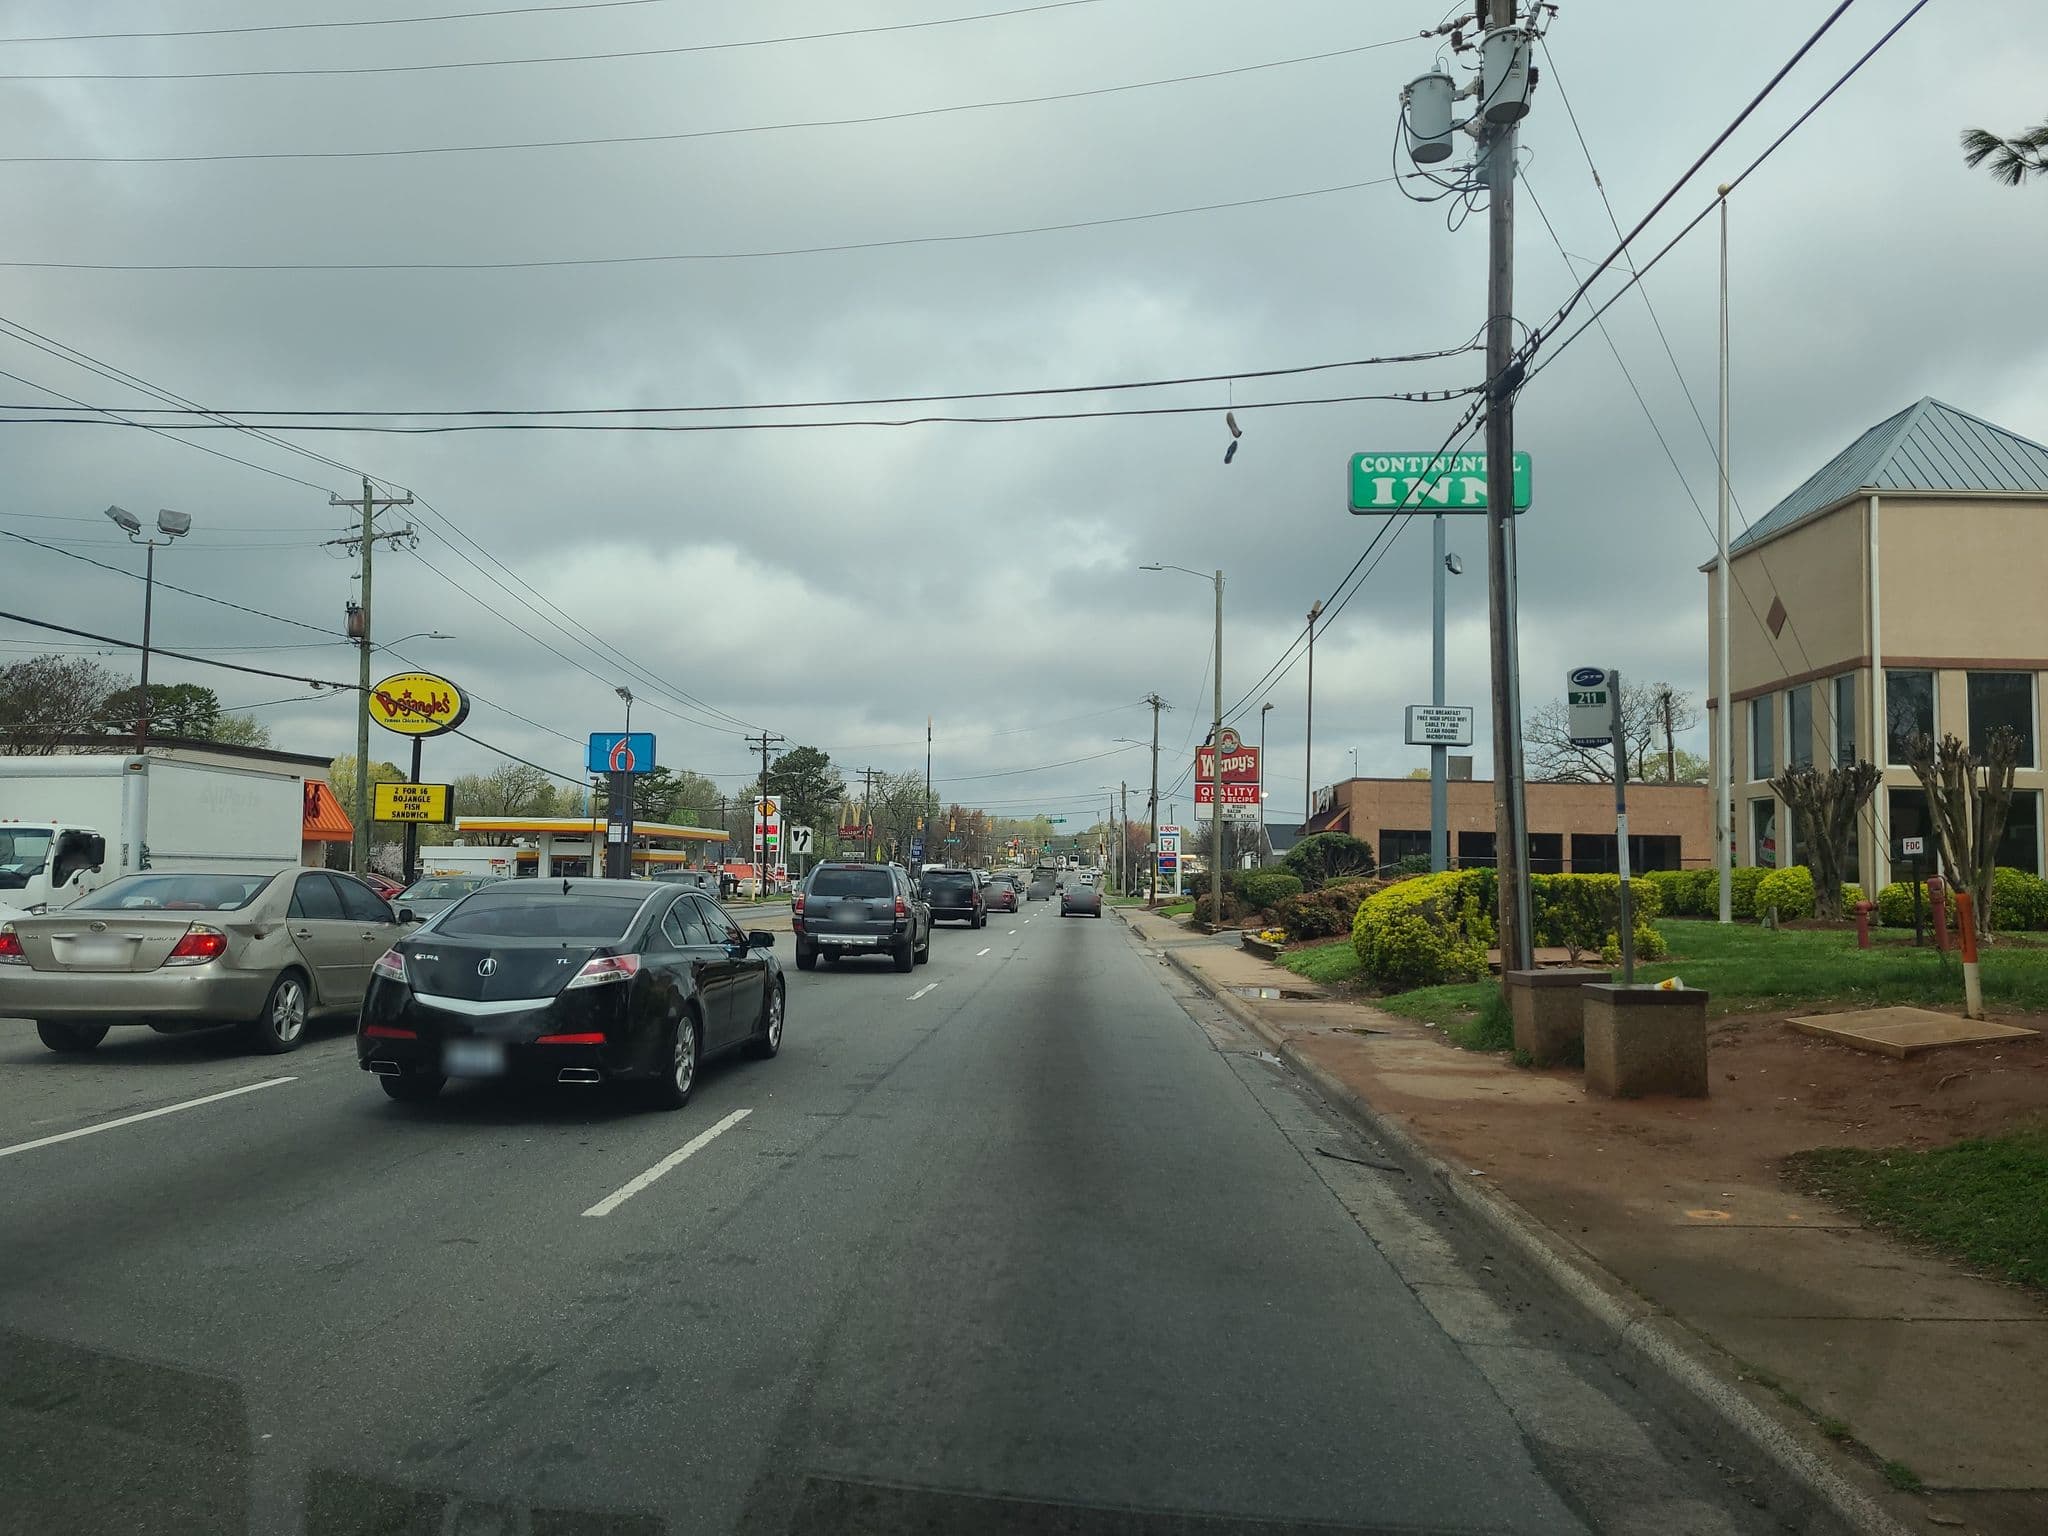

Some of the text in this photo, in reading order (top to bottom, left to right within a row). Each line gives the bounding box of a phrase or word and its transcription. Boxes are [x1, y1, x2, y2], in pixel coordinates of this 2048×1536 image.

[1360, 457, 1521, 472] CONTINENTL
[1577, 692, 1597, 704] 211
[1905, 841, 1920, 850] FDC
